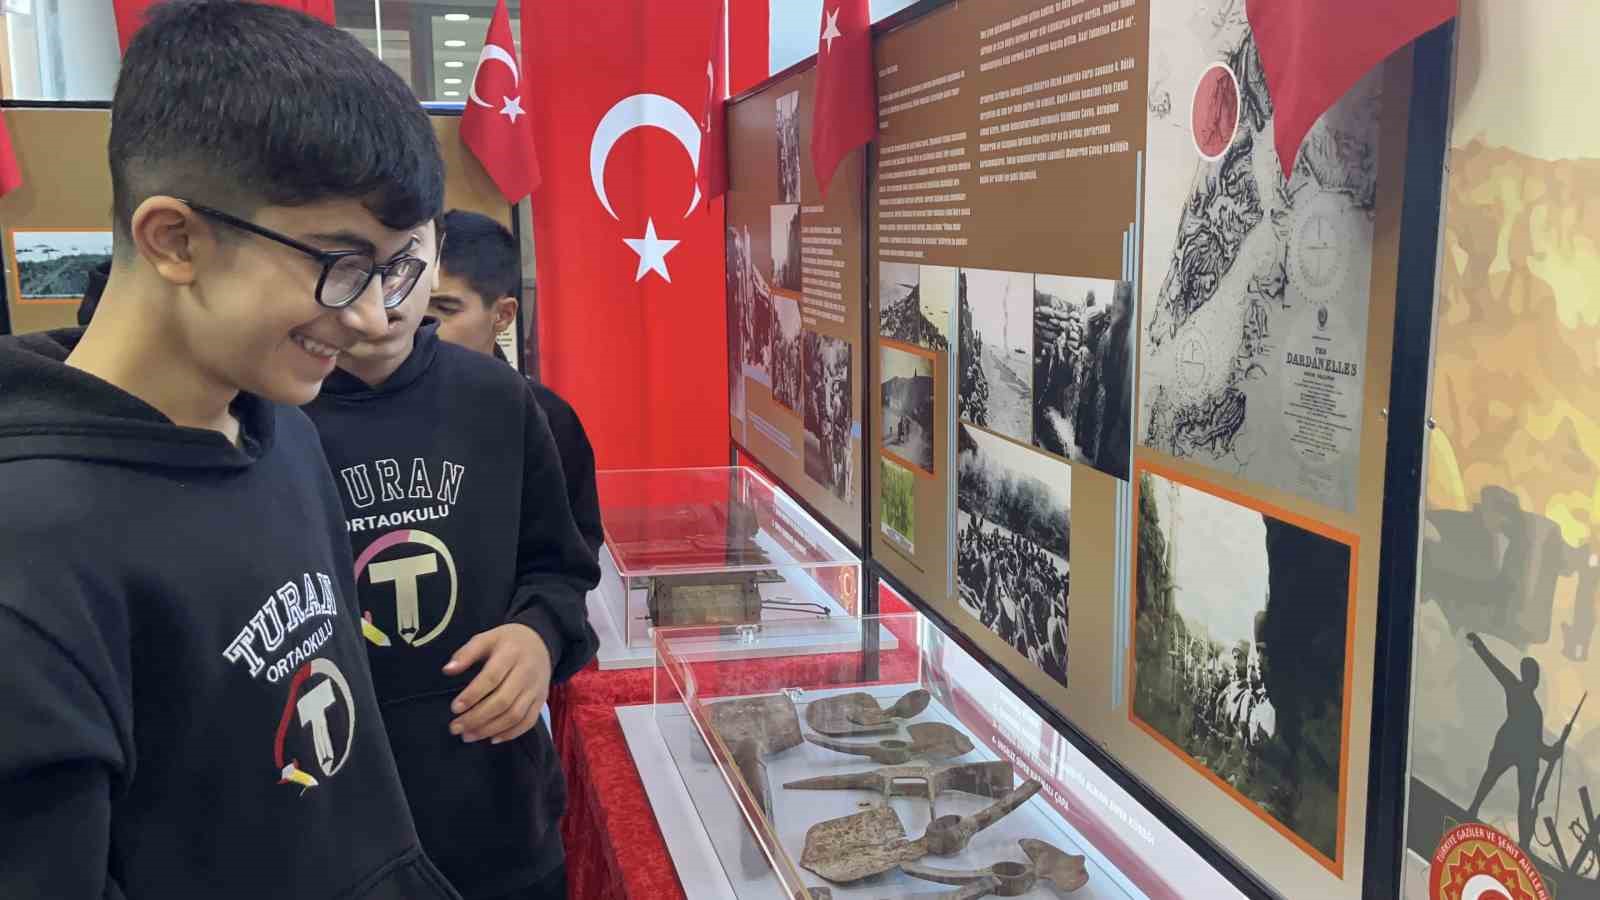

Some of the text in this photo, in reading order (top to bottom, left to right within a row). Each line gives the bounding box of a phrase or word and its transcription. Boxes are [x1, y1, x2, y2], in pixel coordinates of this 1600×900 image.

[1286, 352, 1358, 377] DARDANELLES
[341, 458, 464, 508] URAN
[222, 572, 337, 678] TURAN
[266, 618, 334, 682] ORTAOKULU
[1486, 830, 1497, 842] VE
